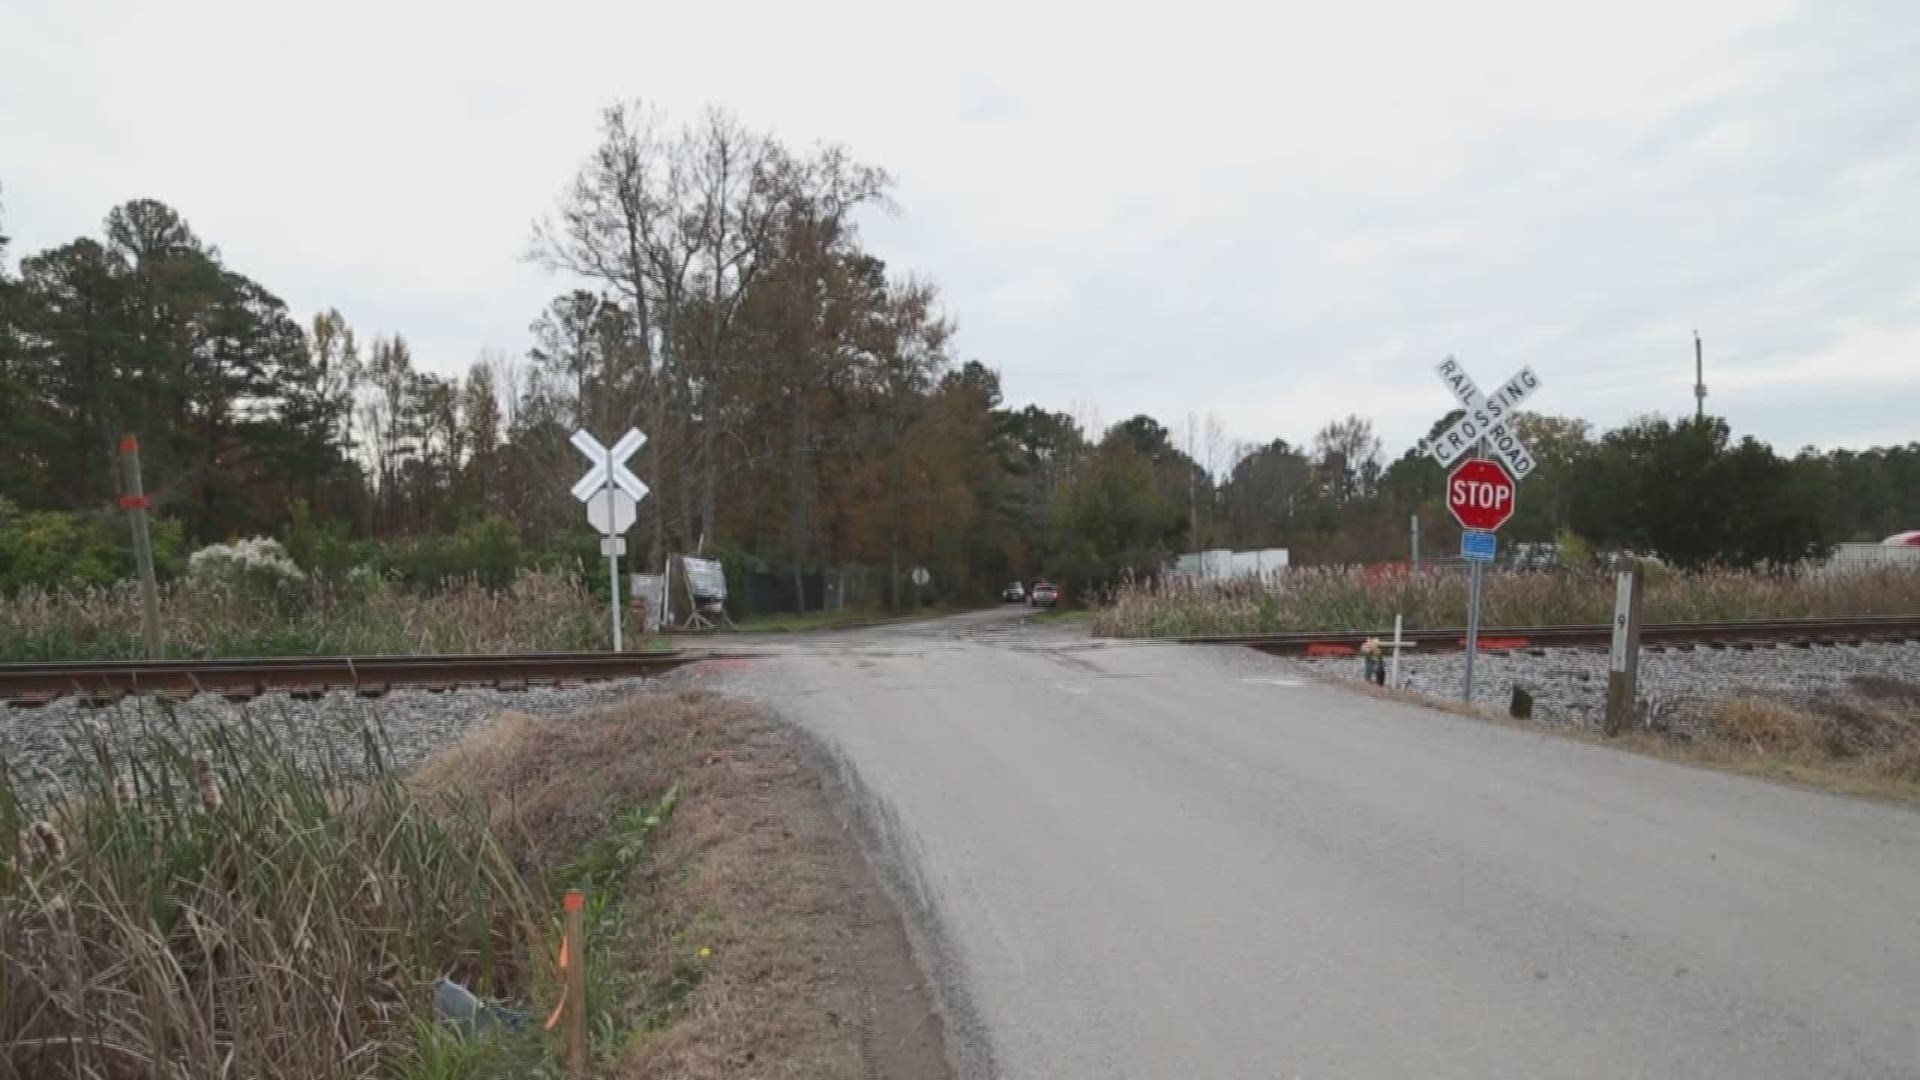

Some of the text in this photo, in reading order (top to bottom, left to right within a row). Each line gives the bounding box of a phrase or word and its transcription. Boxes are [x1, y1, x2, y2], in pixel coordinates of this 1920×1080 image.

[1440, 360, 1476, 406] RAIL
[1435, 371, 1537, 460] CROSSING
[1489, 425, 1530, 473] ROAD
[1452, 480, 1510, 510] STOP
